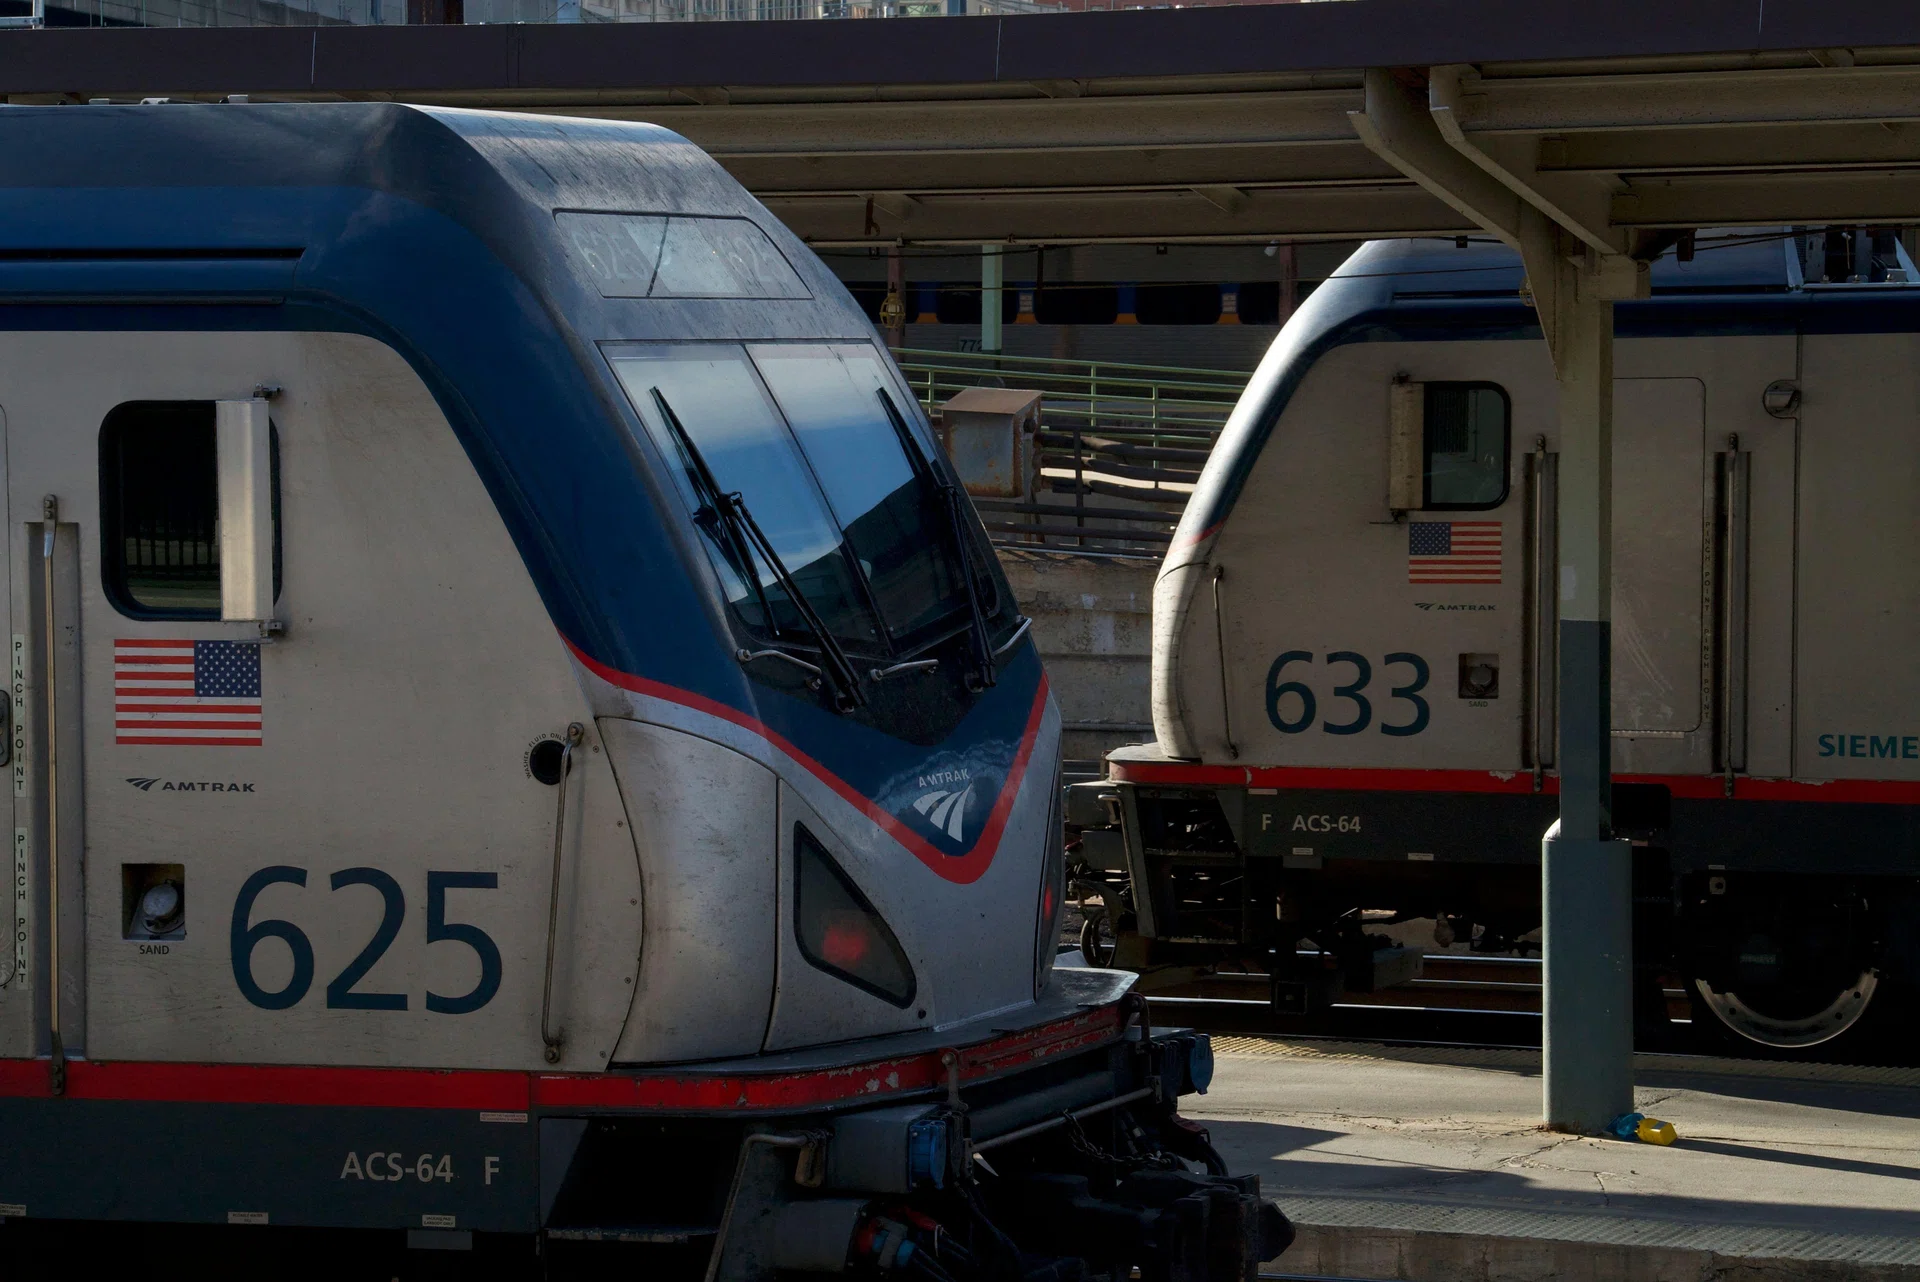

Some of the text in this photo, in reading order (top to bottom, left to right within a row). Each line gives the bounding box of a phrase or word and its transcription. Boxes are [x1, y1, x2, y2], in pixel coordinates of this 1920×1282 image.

[1266, 650, 1430, 736] 633
[15, 642, 24, 790] PINCH POINT
[523, 751, 532, 779] WASHER
[529, 733, 547, 748] FLUID
[1818, 734, 1919, 759] SIEME
[162, 781, 255, 793] AMTRAK
[919, 768, 970, 788] AMTRAK
[1261, 813, 1361, 833] F ACS-64
[17, 835, 26, 983] PINCH POINT
[139, 944, 170, 955] SAND
[231, 865, 502, 1014] 625
[340, 1151, 500, 1185] ACS-64 F
